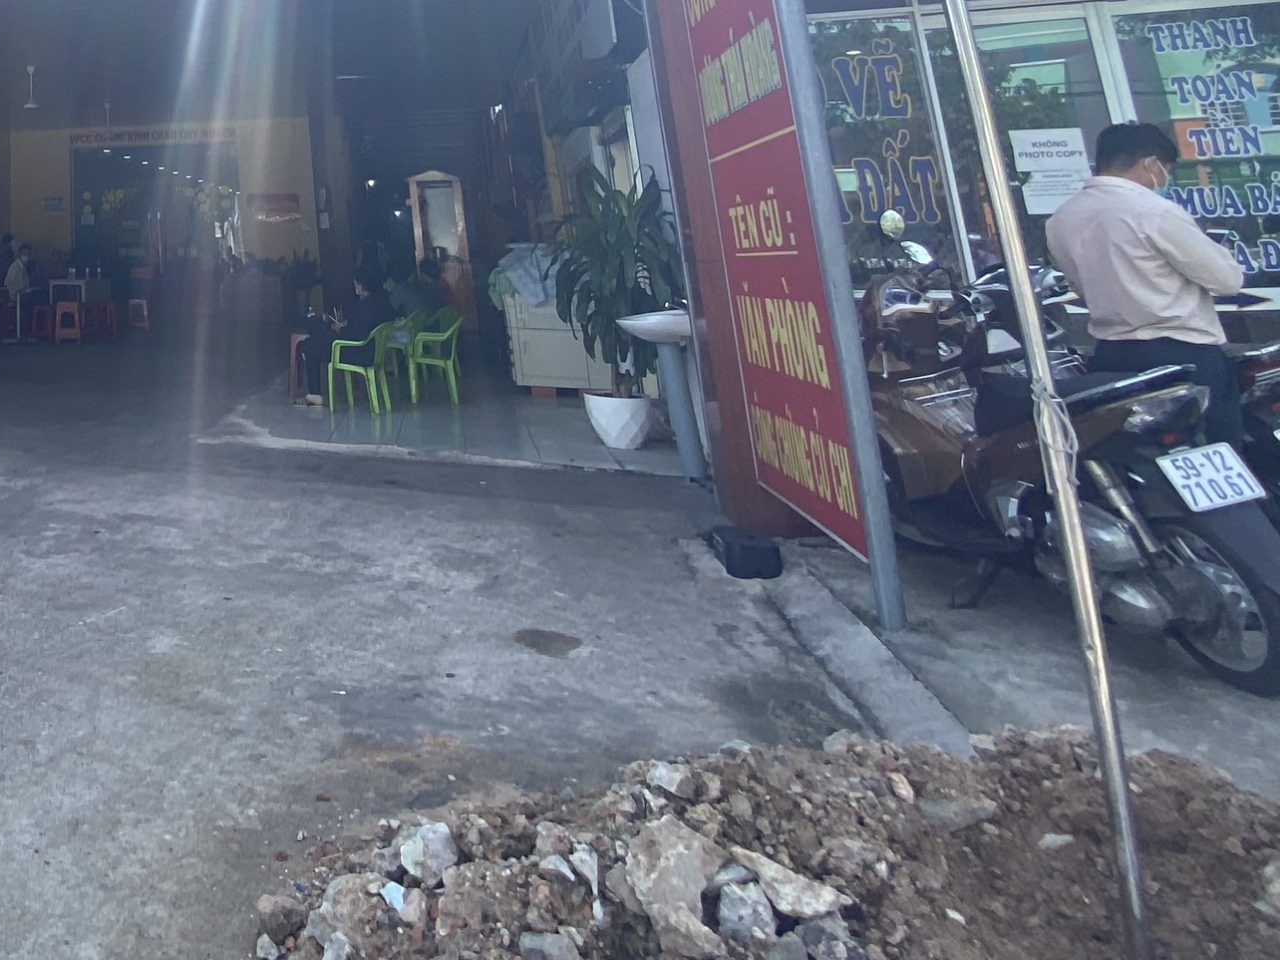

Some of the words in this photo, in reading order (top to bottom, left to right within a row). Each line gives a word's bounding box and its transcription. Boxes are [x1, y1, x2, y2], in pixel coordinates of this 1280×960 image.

[1146, 16, 1257, 53] THANH
[832, 38, 912, 120] VẼ
[1170, 63, 1258, 104] TOÁN
[1031, 140, 1068, 149] KHÔNG
[1188, 109, 1262, 158] TIỀN
[851, 129, 941, 224] ĐẤT
[729, 194, 759, 248] TÊN
[1170, 184, 1245, 218] MUA
[736, 281, 770, 369] VĂN
[765, 277, 831, 390] PHÒNG
[828, 439, 858, 520] CHI
[1170, 450, 1233, 480] 59-Y2
[1181, 472, 1255, 506] 710.61
